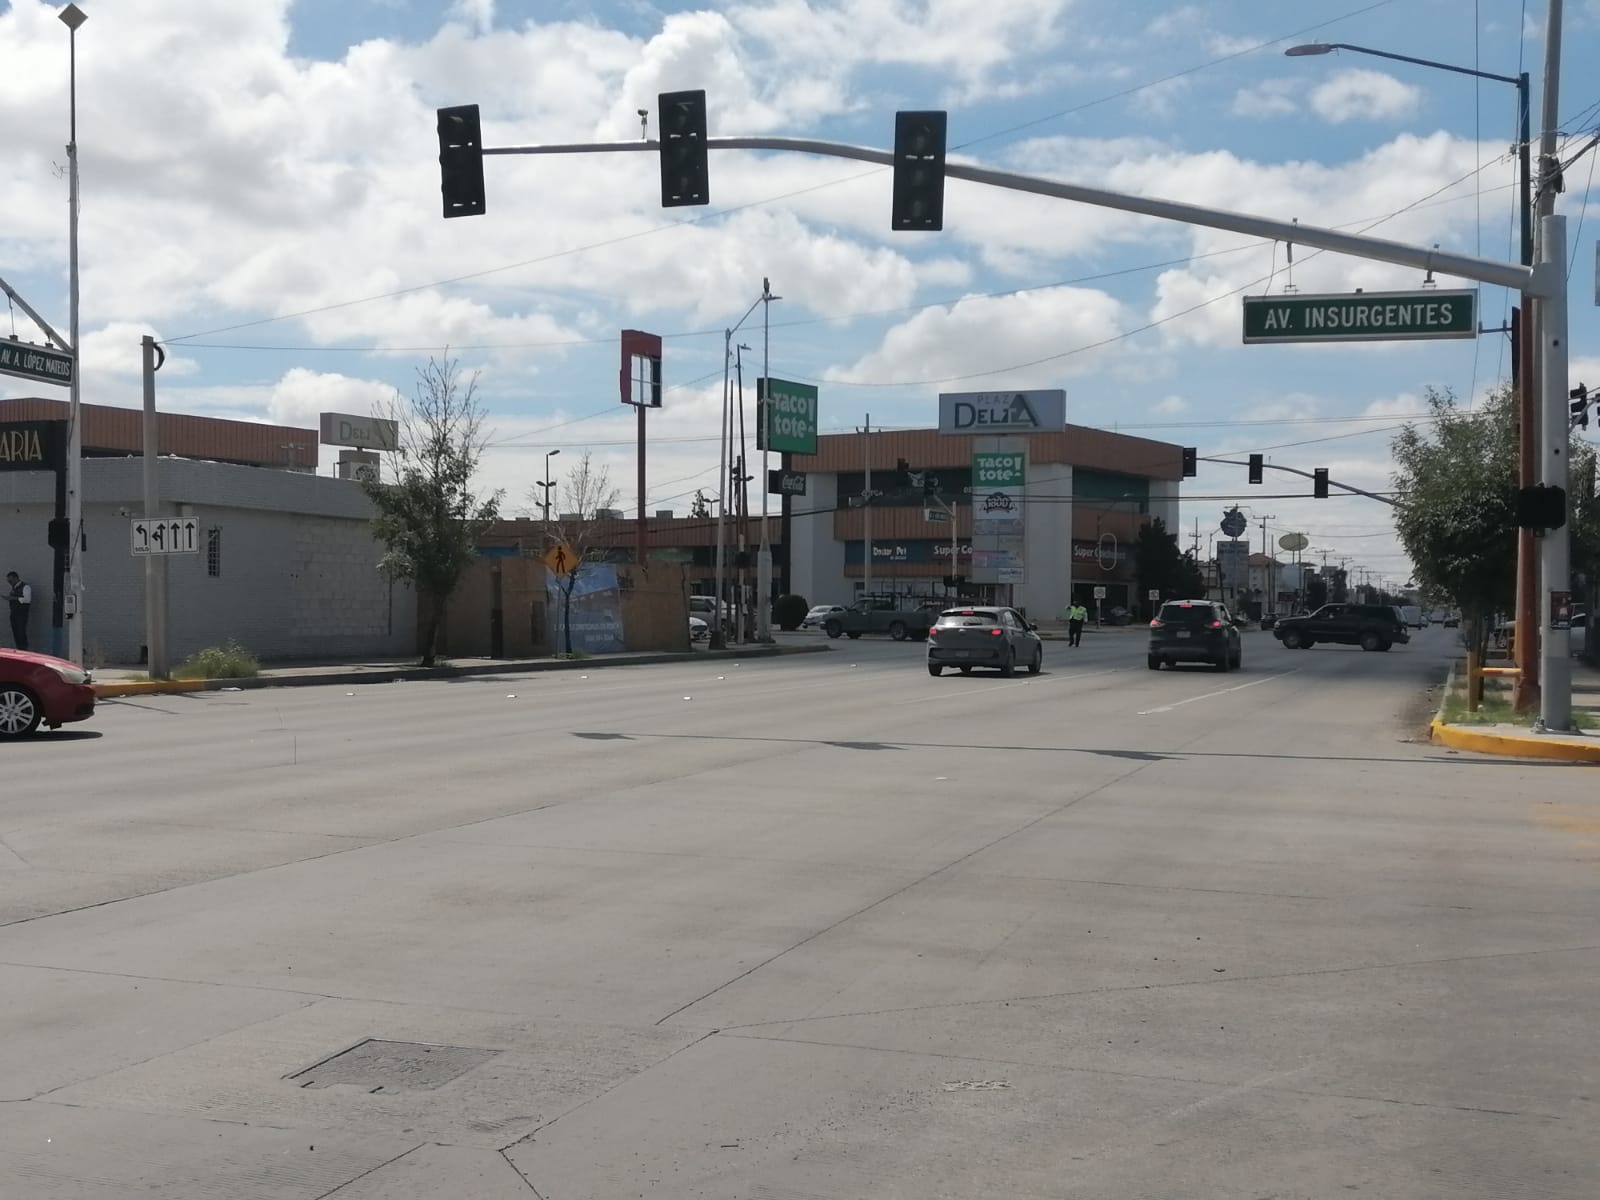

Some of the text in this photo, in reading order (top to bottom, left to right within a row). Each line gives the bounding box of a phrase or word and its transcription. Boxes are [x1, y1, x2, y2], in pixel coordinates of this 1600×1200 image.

[1264, 303, 1453, 329] AV. INSURGENTES
[23, 352, 45, 371] LÓPEZ
[45, 357, 71, 377] MATEOS
[954, 394, 1039, 429] DELTA
[0, 429, 43, 462] ARIA
[933, 545, 961, 557] Super
